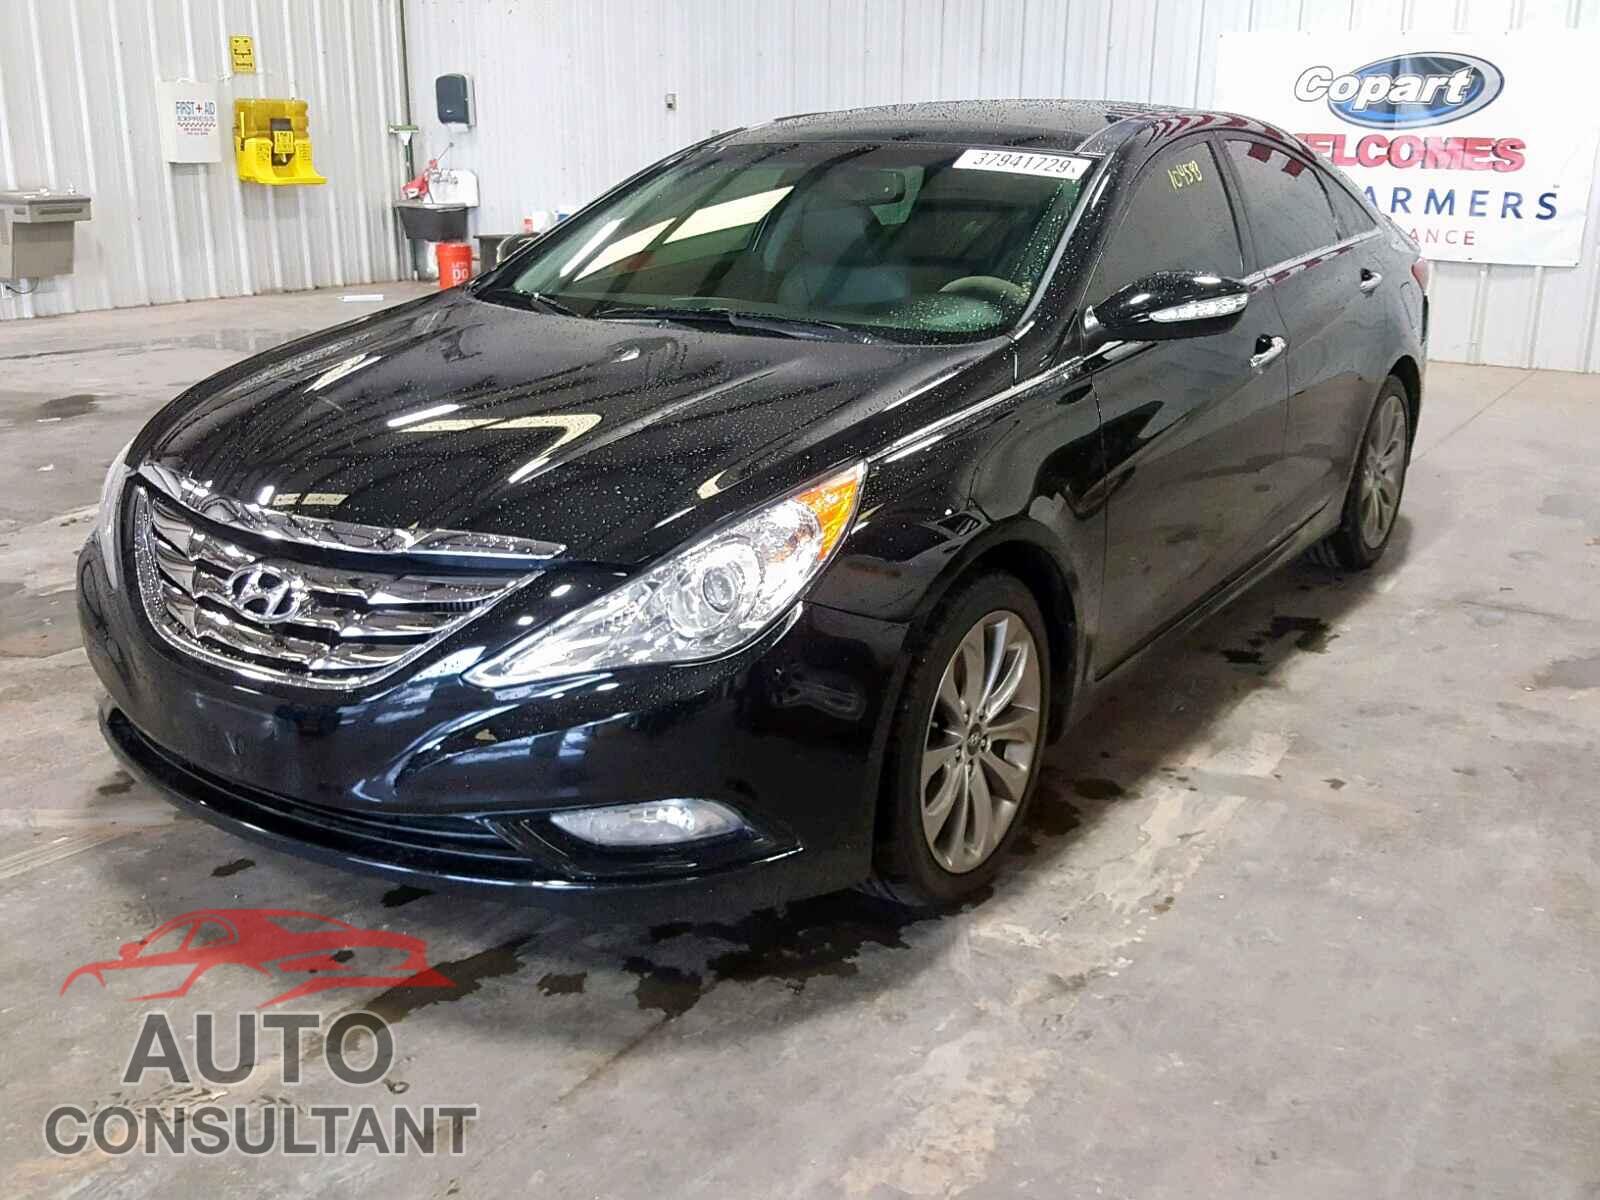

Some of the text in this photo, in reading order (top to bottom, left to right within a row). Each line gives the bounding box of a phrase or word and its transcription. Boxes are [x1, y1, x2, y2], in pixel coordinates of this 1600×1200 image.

[1294, 65, 1475, 112] Copart
[973, 152, 1072, 173] 37941729
[1294, 133, 1527, 173] ELCOMES
[1363, 185, 1558, 220] ARMERS
[1408, 228, 1476, 246] ANCE
